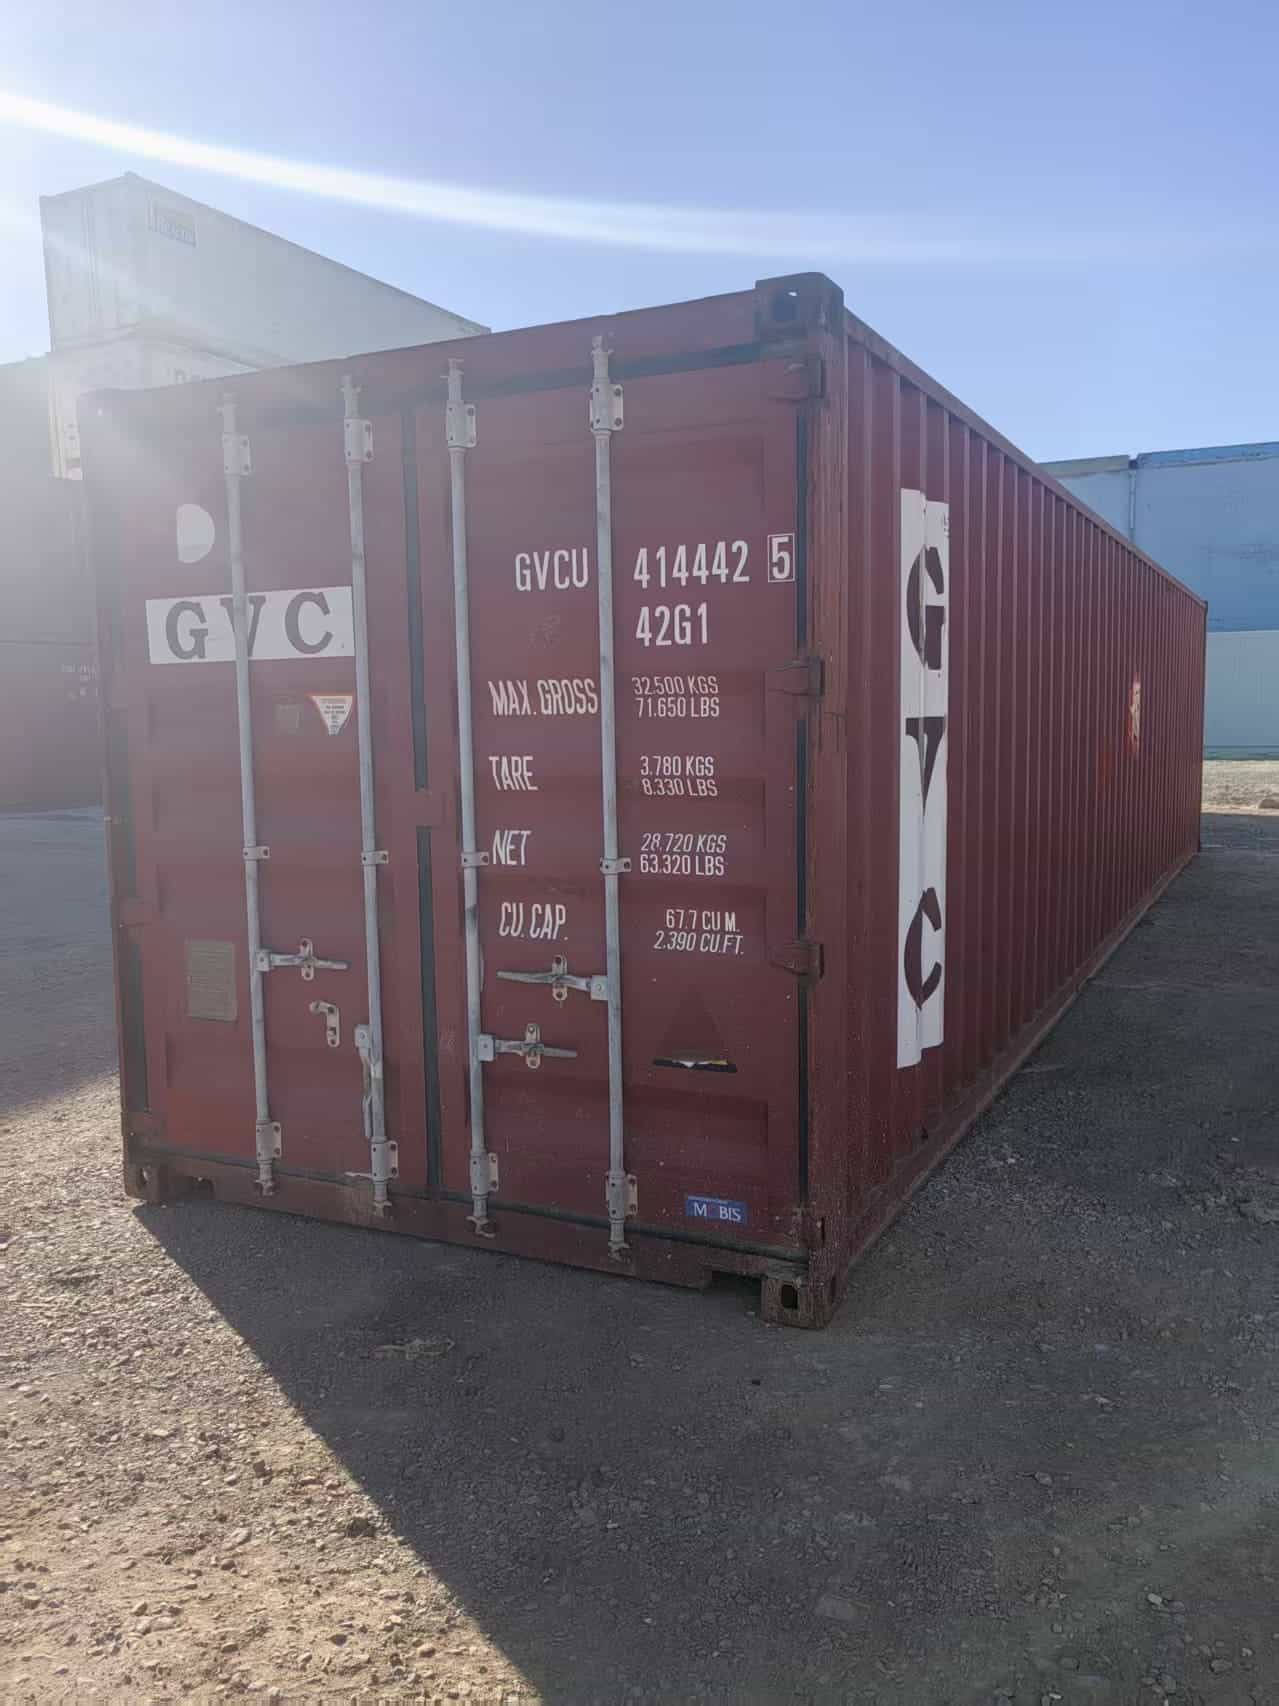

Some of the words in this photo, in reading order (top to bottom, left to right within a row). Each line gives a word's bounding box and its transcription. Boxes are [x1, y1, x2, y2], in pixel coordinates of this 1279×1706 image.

[515, 548, 590, 592] GVCU
[633, 540, 750, 589] 414442
[770, 536, 791, 579] 5
[165, 591, 334, 660] GVC
[635, 602, 709, 647] 42G1
[631, 676, 685, 695] 32.500
[687, 675, 719, 695] KGS
[487, 680, 537, 716] MAX.
[537, 678, 599, 715] GROSS
[635, 697, 687, 718] 71.650
[690, 697, 721, 718] LBS
[488, 755, 539, 791] TARE
[640, 755, 682, 777] 3.780
[685, 755, 715, 777] KGS
[641, 778, 685, 796] 8.330
[686, 778, 719, 797] LBS
[903, 545, 947, 1013] GVC
[492, 829, 532, 866] NET
[640, 832, 694, 853] 28.720
[695, 833, 728, 854] KGS
[640, 854, 692, 875] 63.320
[695, 855, 725, 876] LBS
[665, 909, 697, 931] 67.7
[653, 931, 697, 951] 2.390
